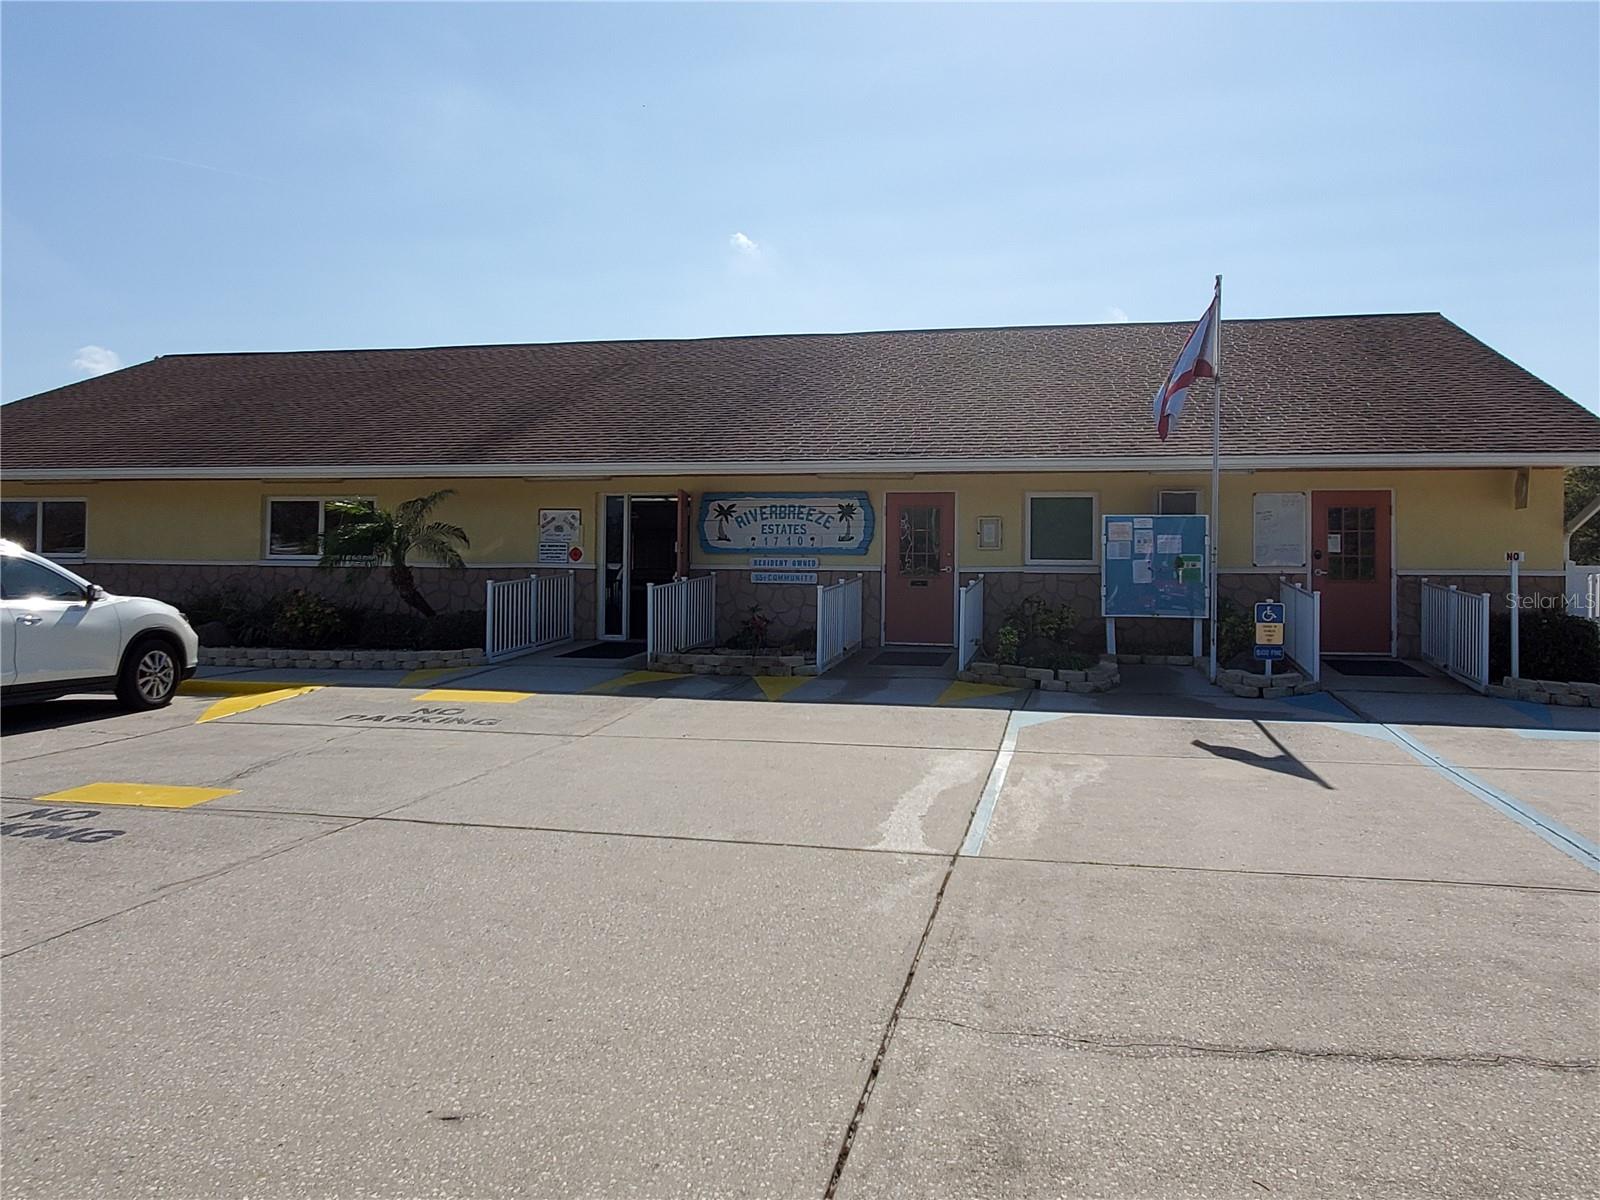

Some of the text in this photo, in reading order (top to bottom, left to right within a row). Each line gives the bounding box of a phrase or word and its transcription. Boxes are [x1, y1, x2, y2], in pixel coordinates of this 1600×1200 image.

[734, 504, 836, 530] RIVERBREEZE
[761, 523, 808, 535] ESTATES
[763, 536, 804, 546] 1710
[1506, 552, 1520, 561] NO
[753, 559, 817, 567] RESIDENT OWNED
[411, 707, 466, 716] NO
[334, 714, 503, 726] PARKING
[4, 807, 102, 822] NO
